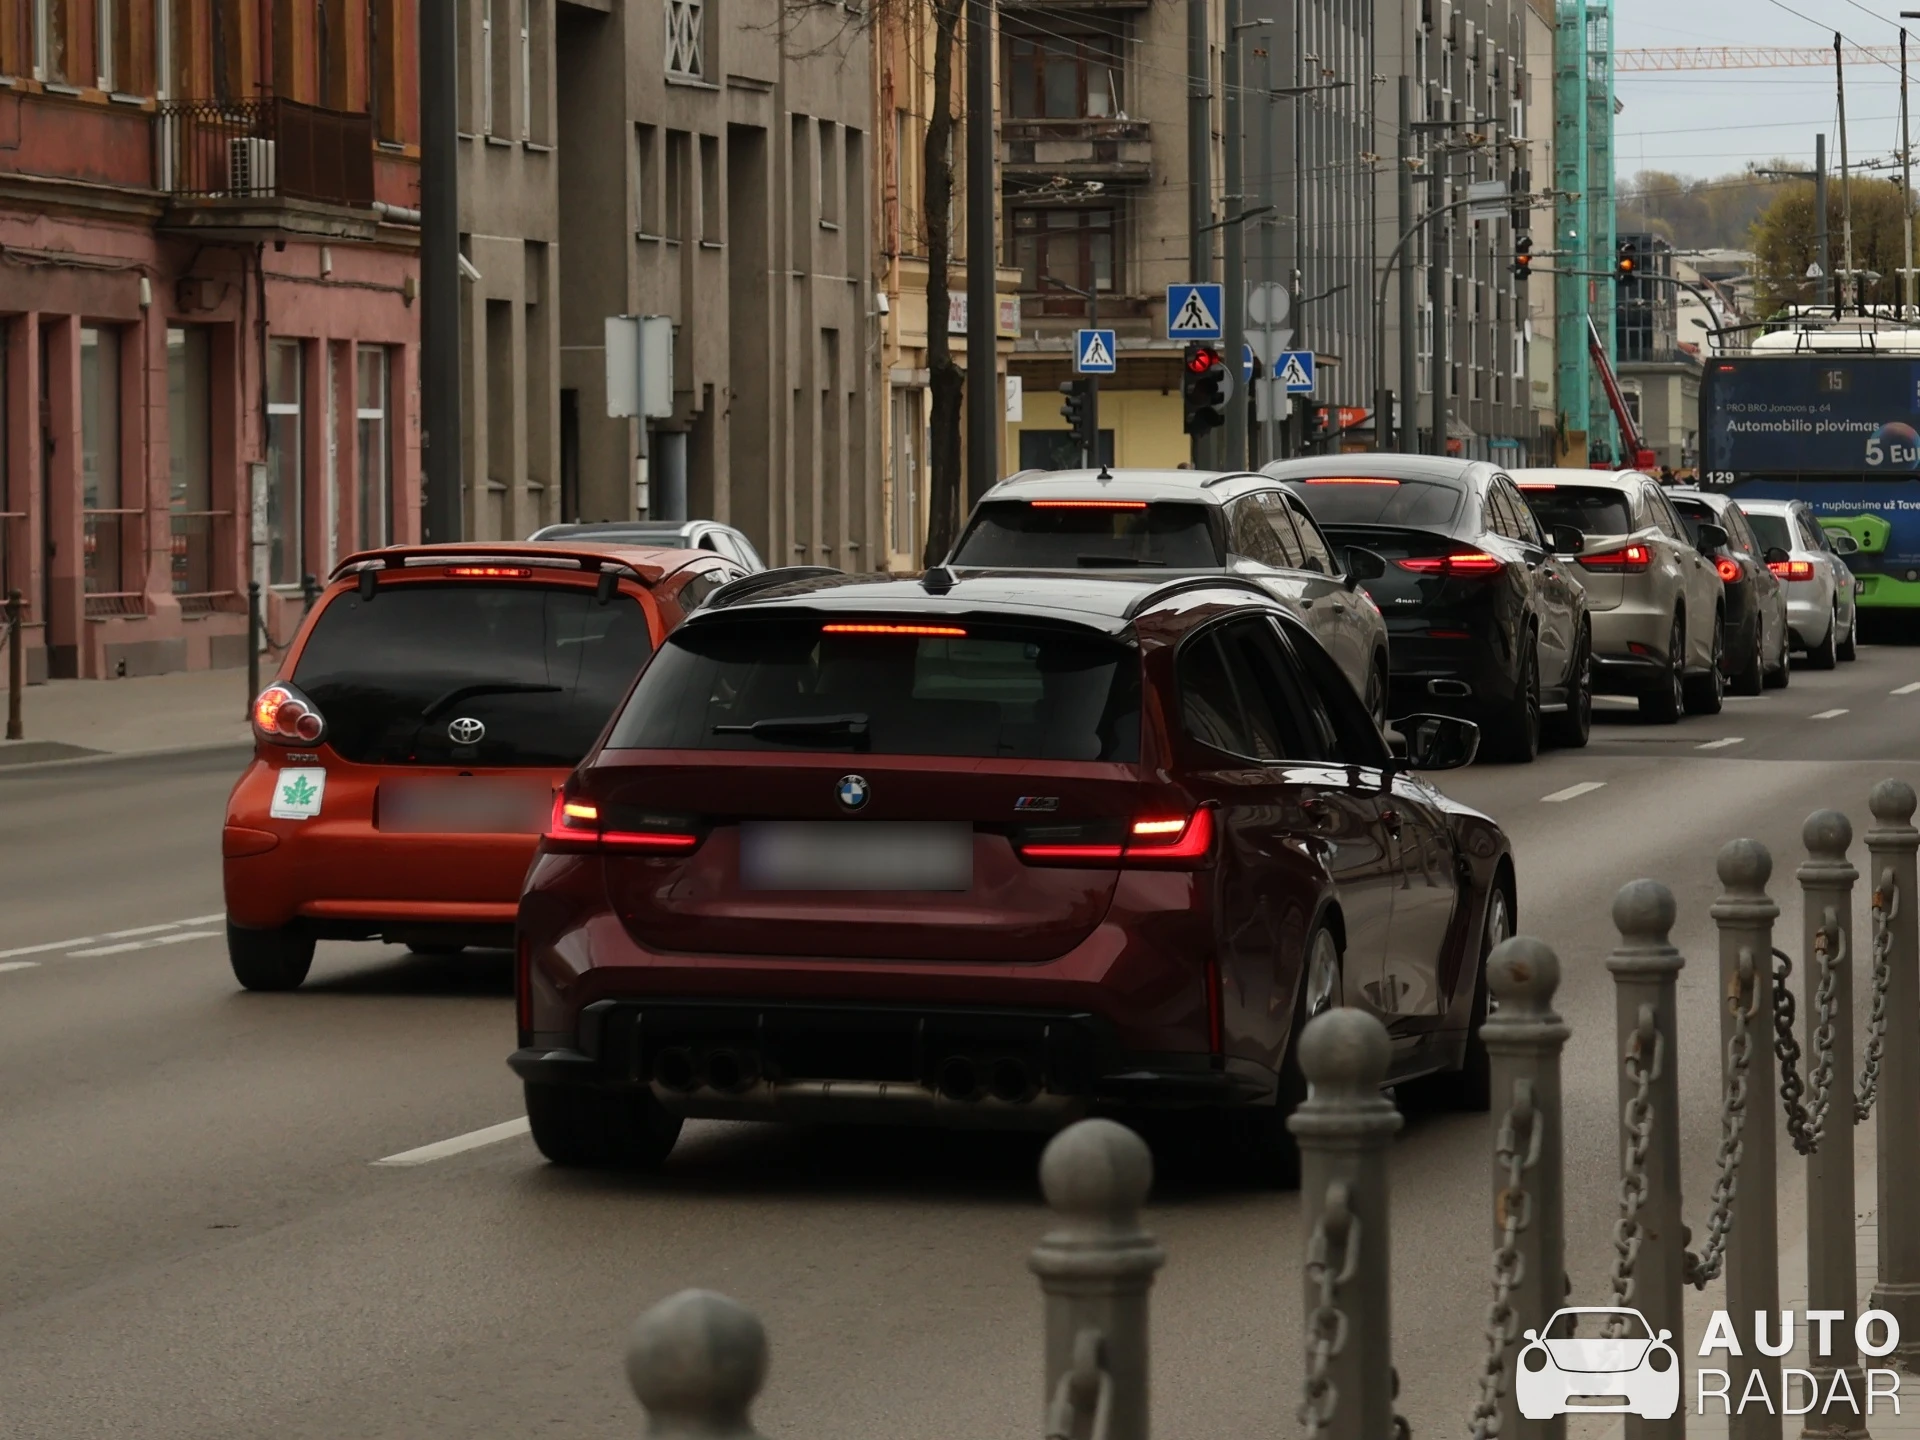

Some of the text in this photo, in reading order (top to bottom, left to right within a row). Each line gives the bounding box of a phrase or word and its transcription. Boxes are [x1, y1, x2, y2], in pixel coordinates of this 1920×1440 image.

[1827, 371, 1842, 390] 15
[1726, 403, 1746, 412] PRO
[1747, 403, 1768, 412] BRO
[1769, 403, 1807, 413] Jonavos
[1819, 403, 1831, 412] 64
[1726, 418, 1880, 434] Automobilio plovimas
[1865, 437, 1884, 466] 5
[1706, 472, 1735, 484] 129
[1822, 500, 1881, 511] nuplausime
[1883, 500, 1896, 510] už
[286, 752, 319, 762] TOYOTA
